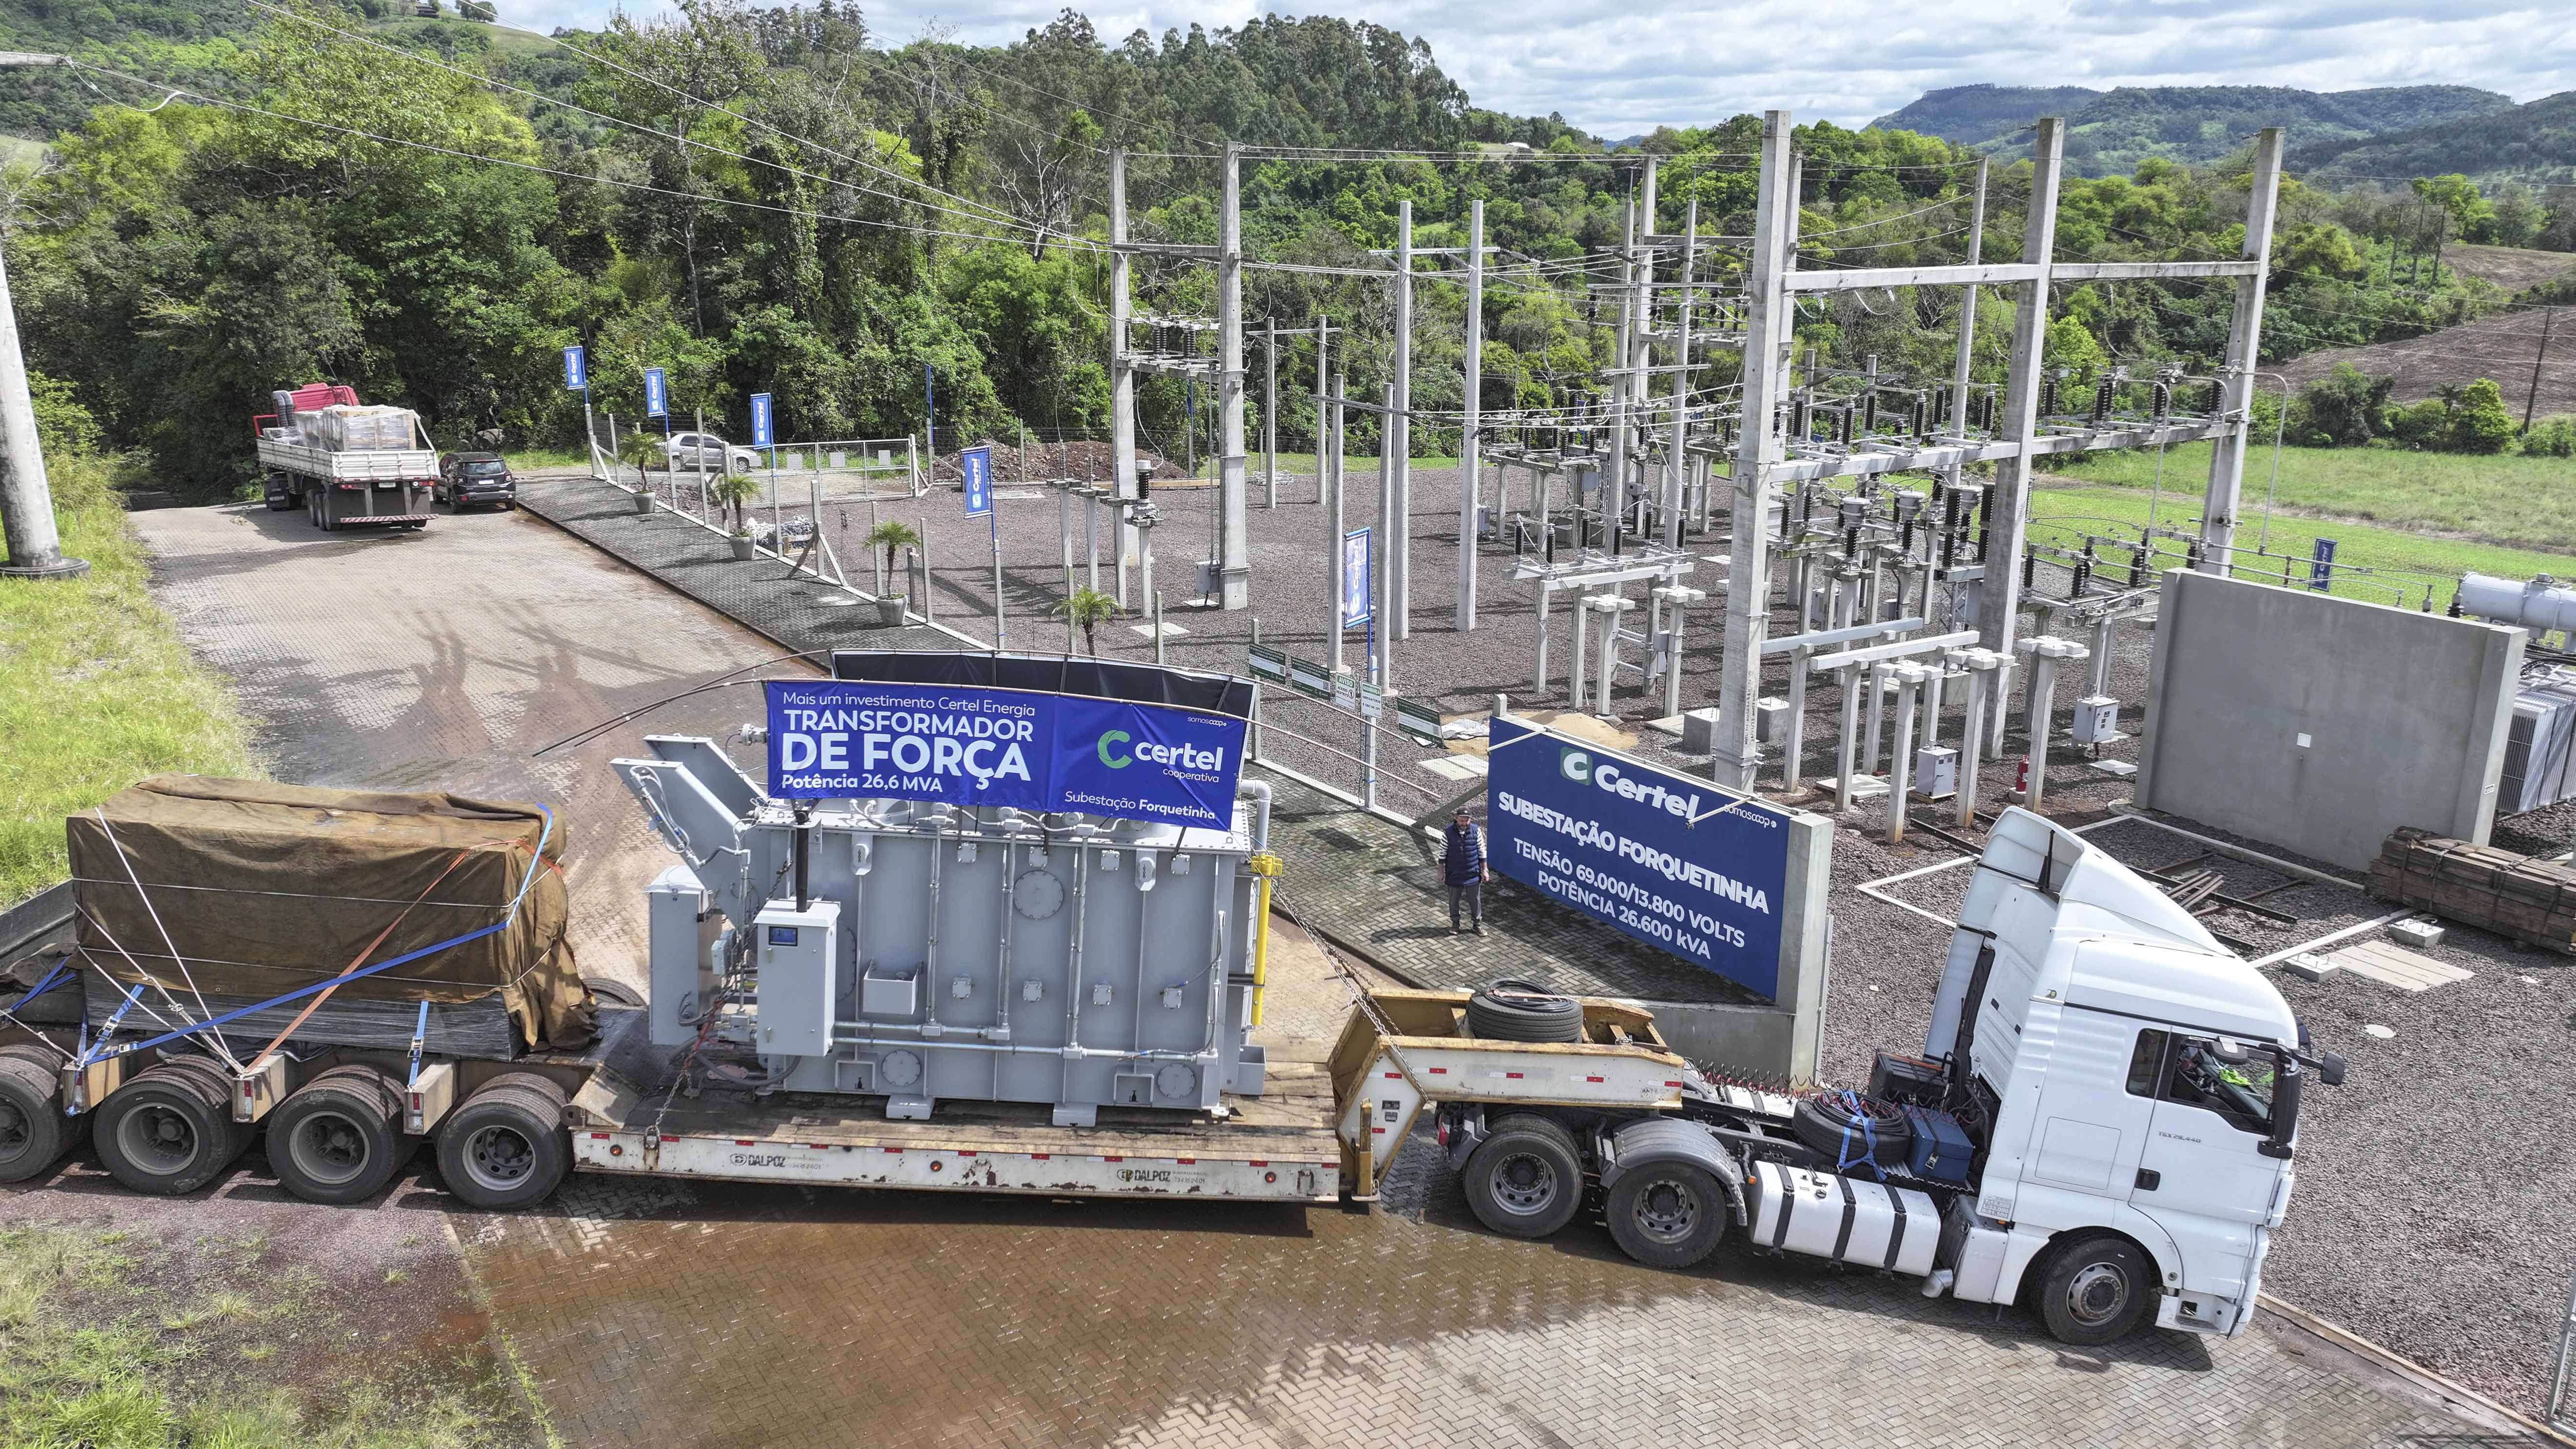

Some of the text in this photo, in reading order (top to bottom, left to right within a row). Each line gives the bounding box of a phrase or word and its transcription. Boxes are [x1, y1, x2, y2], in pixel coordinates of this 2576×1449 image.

[1339, 676, 1353, 687] AVISO
[783, 692, 1035, 718] Mais um investimento Certel Energia
[784, 709, 1033, 742] TRANSFORMADOR
[1187, 716, 1224, 727] somoscoop
[782, 732, 1031, 790] DE FORÇA
[782, 773, 943, 792] Potência 26,6 MVA
[1163, 768, 1219, 783] cooperativa
[1065, 791, 1215, 820] Subestação Forquetinha
[1595, 765, 1700, 820] Certel
[1499, 791, 1770, 915] SUBESTAÇÃO FORQUETINHA
[1513, 837, 1746, 948] TENSÃO 69.000/13.800 VOLTS
[1538, 870, 1711, 960] POTÊNCIA 26.600 kVA
[748, 1154, 786, 1167] DALPOZ
[1134, 1169, 1171, 1182] DALPOZ
